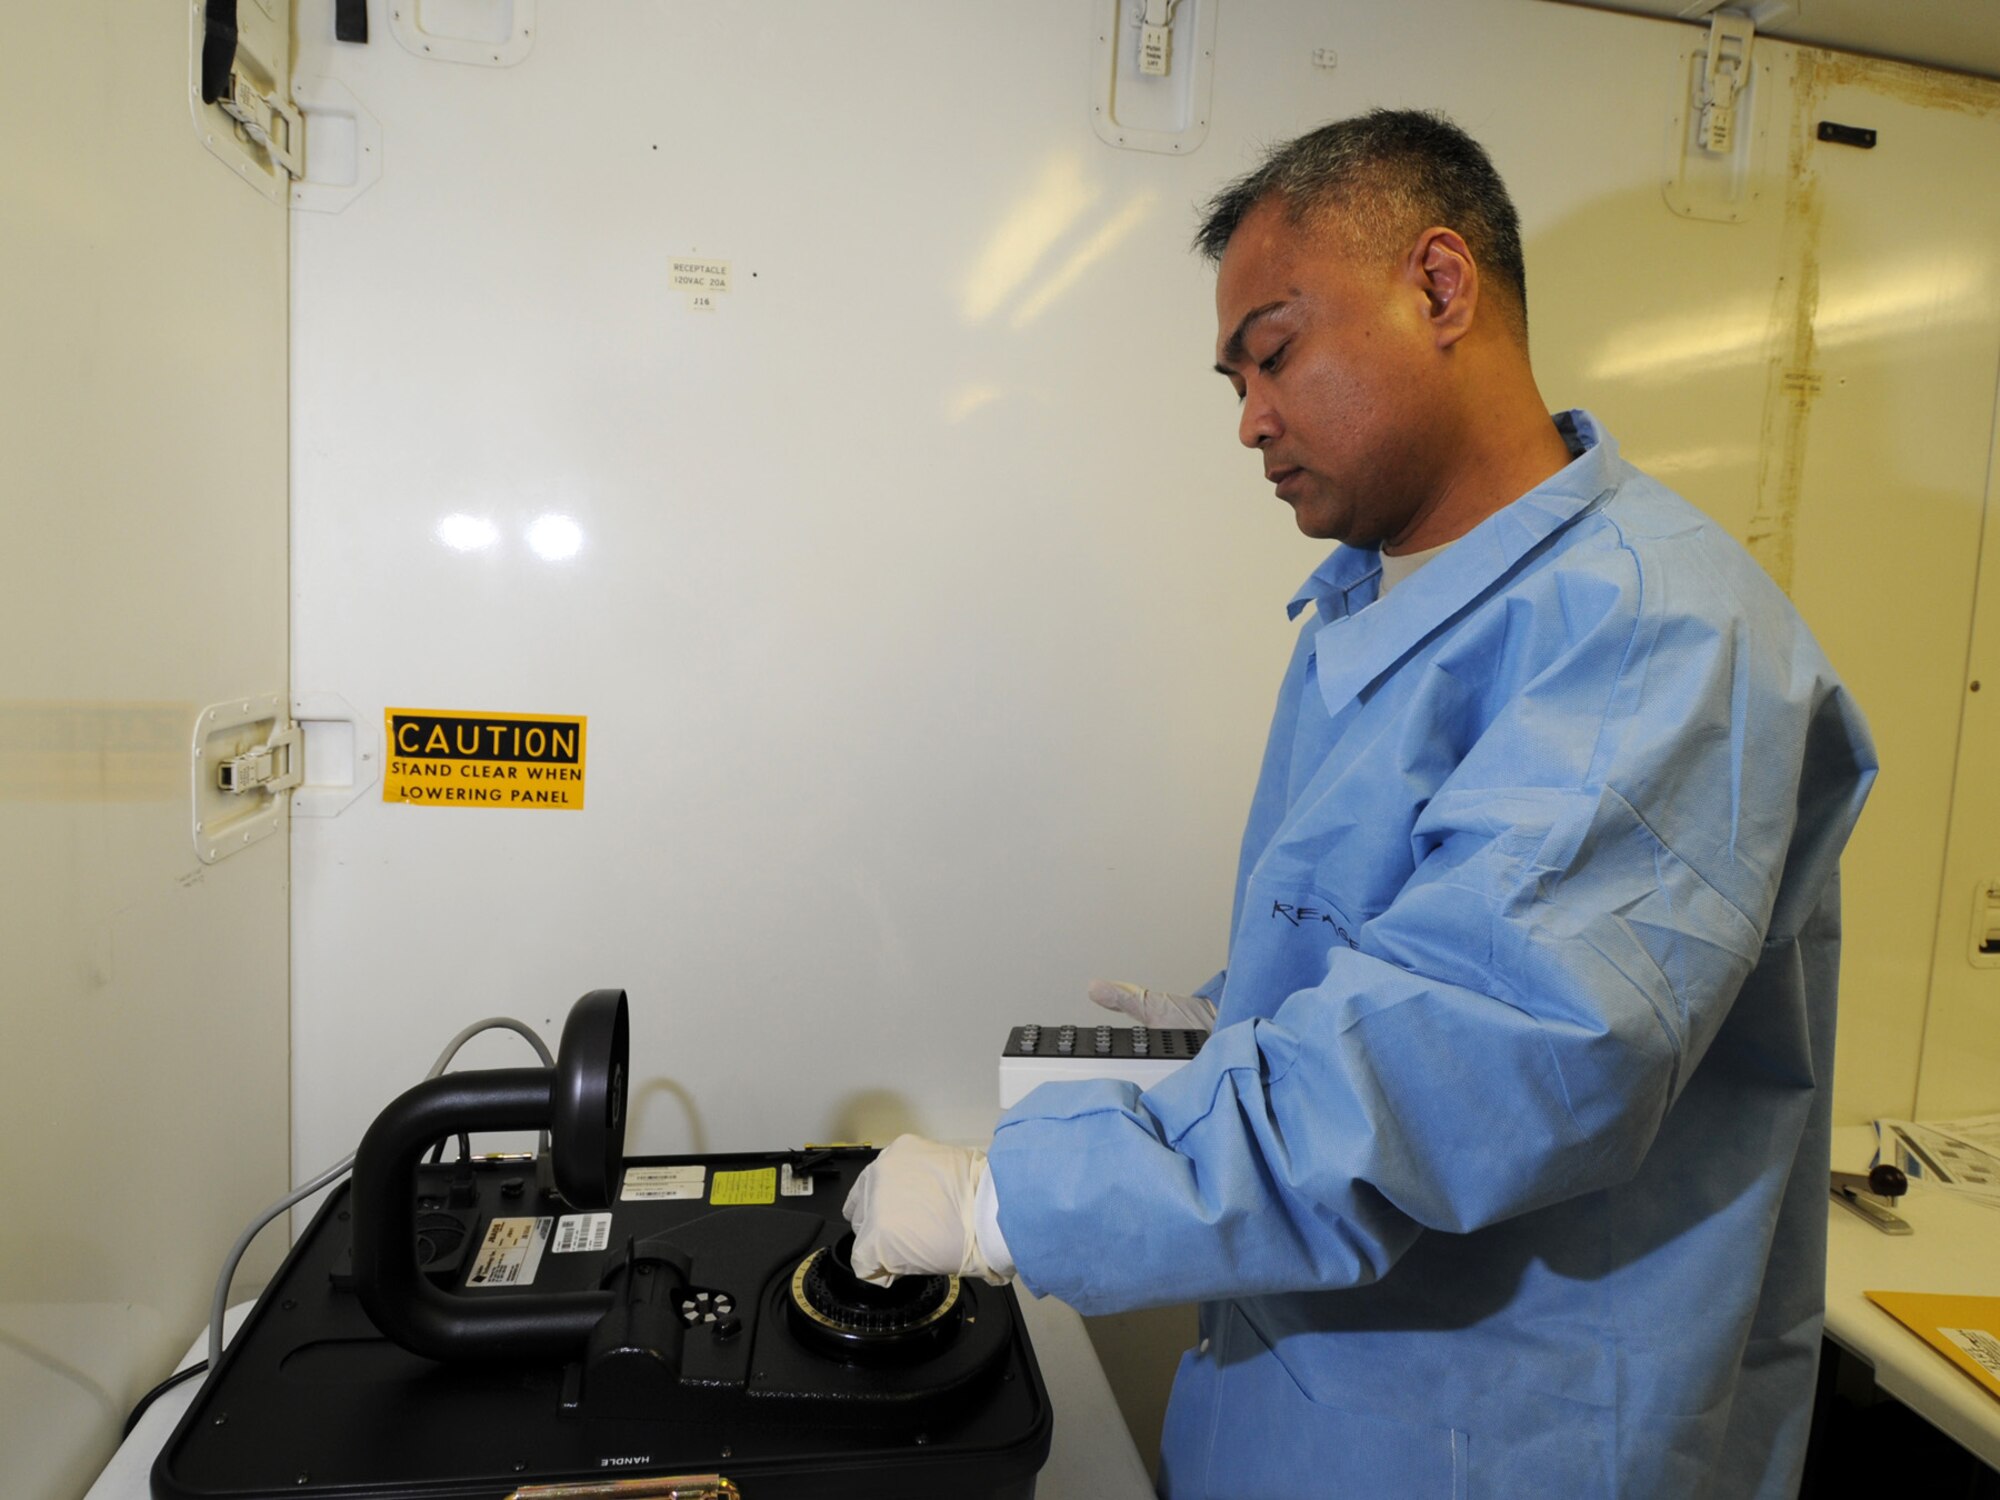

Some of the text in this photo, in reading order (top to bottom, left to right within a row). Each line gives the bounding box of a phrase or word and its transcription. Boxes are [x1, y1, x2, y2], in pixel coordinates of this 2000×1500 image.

[673, 263, 727, 275] RECEPTACLE
[674, 275, 726, 287] 120VAC 20A
[398, 722, 575, 759] CAUTION
[391, 761, 582, 782] STAND CLEAR WHEN
[400, 785, 569, 804] LOWERING PANEL
[600, 1455, 650, 1467] HANDLE
